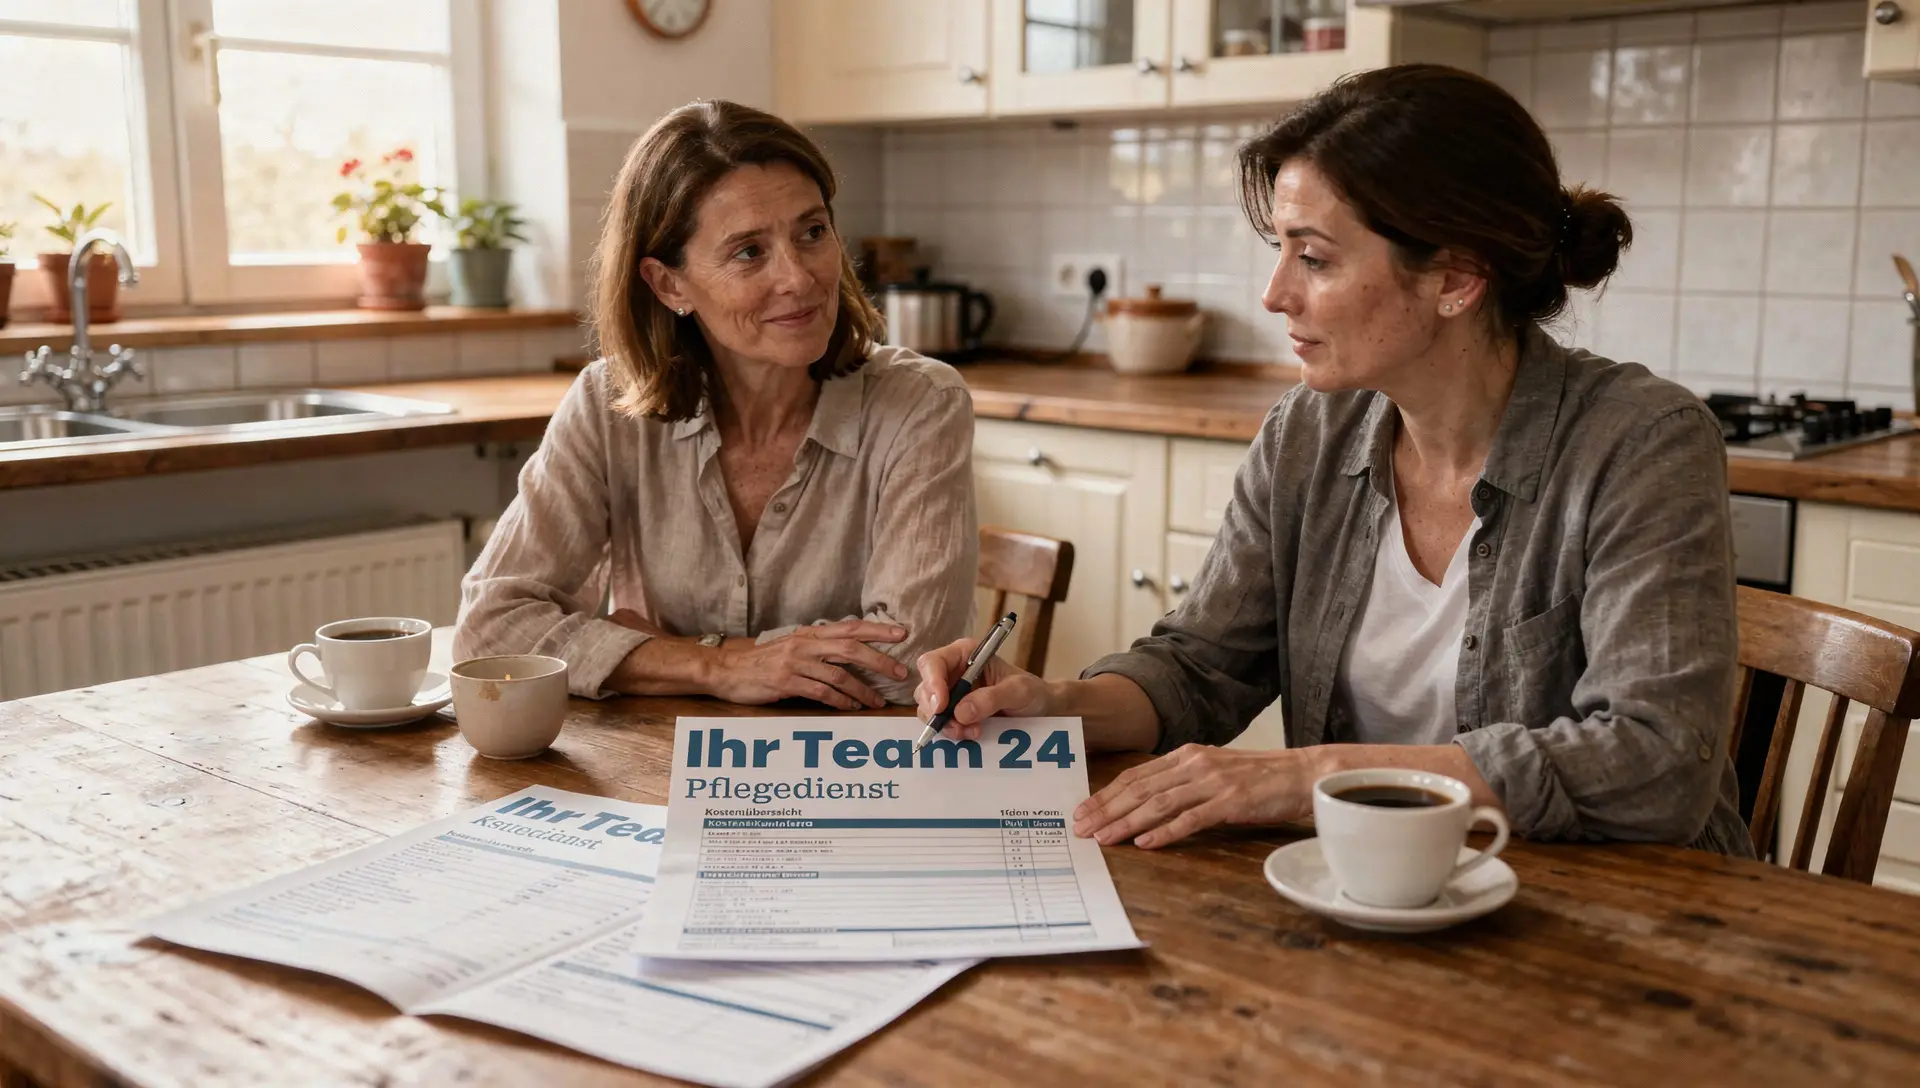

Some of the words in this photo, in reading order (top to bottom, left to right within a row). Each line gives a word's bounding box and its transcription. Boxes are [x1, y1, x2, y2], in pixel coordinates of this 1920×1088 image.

[687, 728, 780, 768] Ihr
[793, 730, 983, 769] Team
[998, 728, 1076, 769] 24
[685, 777, 900, 803] Pflegedienst
[495, 796, 586, 824] Ihr
